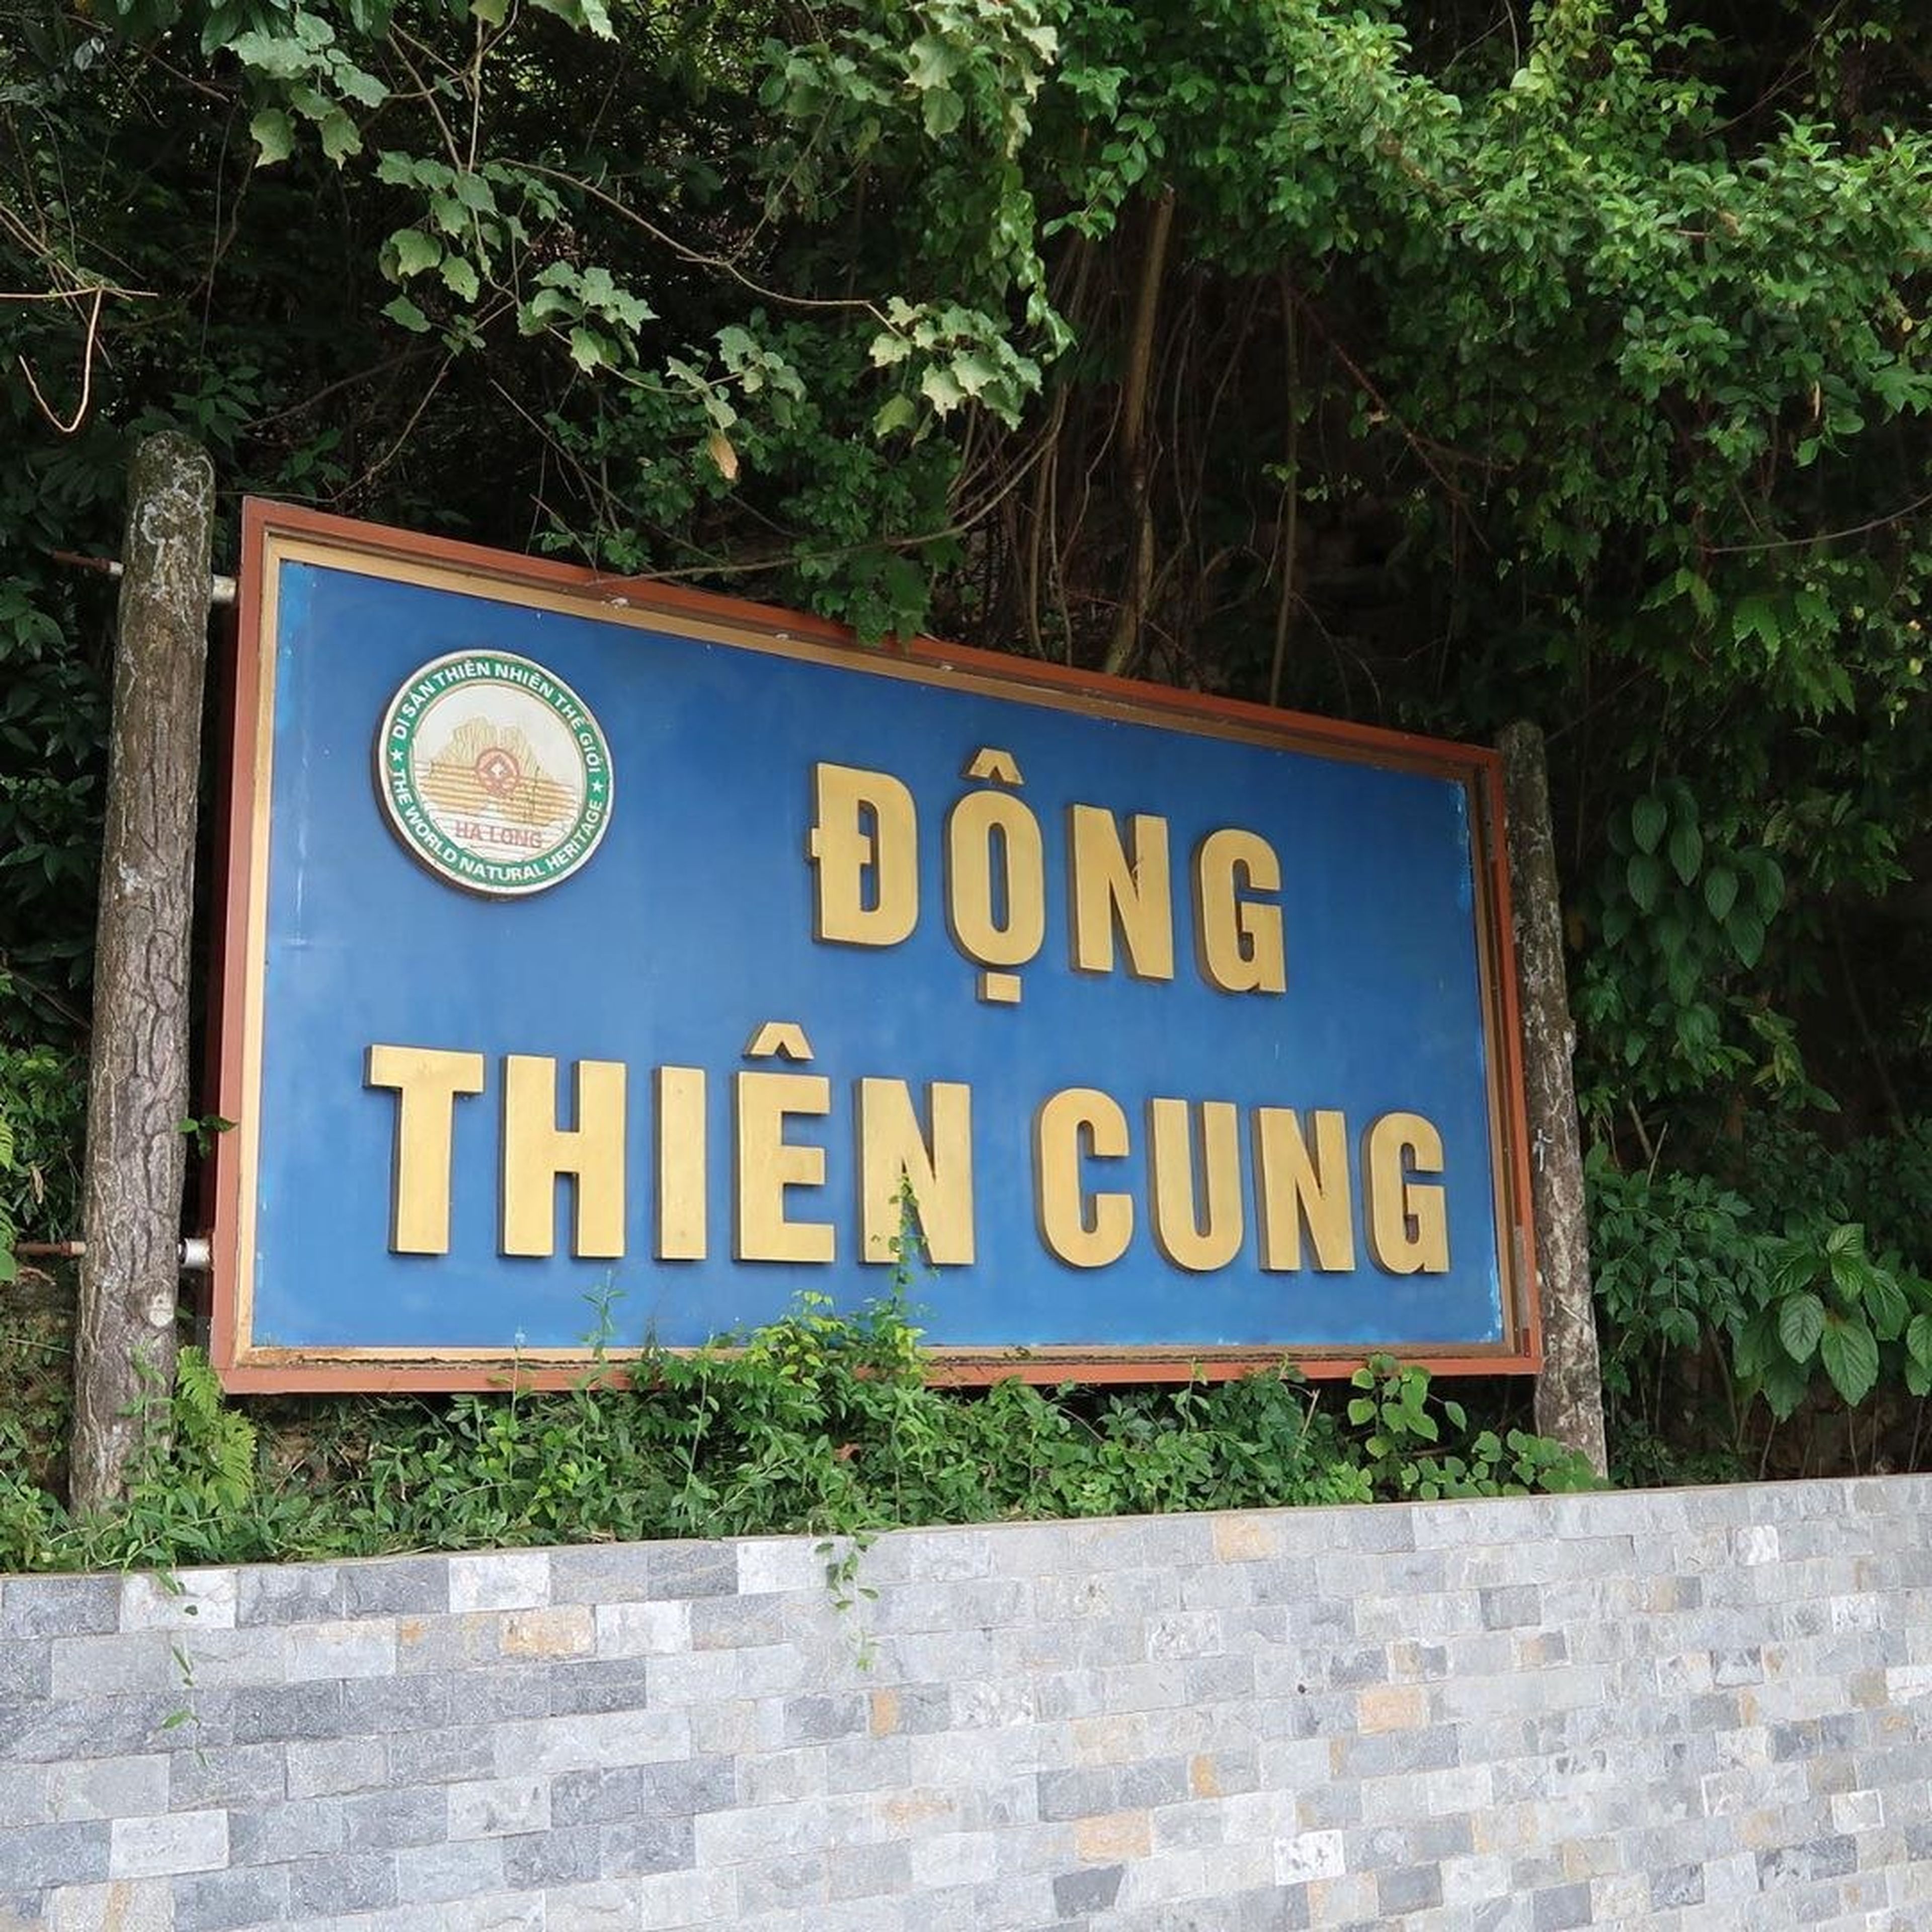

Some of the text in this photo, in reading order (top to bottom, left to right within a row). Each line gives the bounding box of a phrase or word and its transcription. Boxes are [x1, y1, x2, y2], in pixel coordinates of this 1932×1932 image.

[391, 718, 411, 740] DI
[432, 660, 491, 686] THIÊN
[495, 663, 553, 698] NHIÊN
[393, 769, 602, 880] THE WORLD NATURAL HERITAGE
[490, 826, 543, 848] LONG
[809, 750, 1285, 1003] ĐỘNG
[365, 1023, 1448, 1274] THIÊN CUNG
